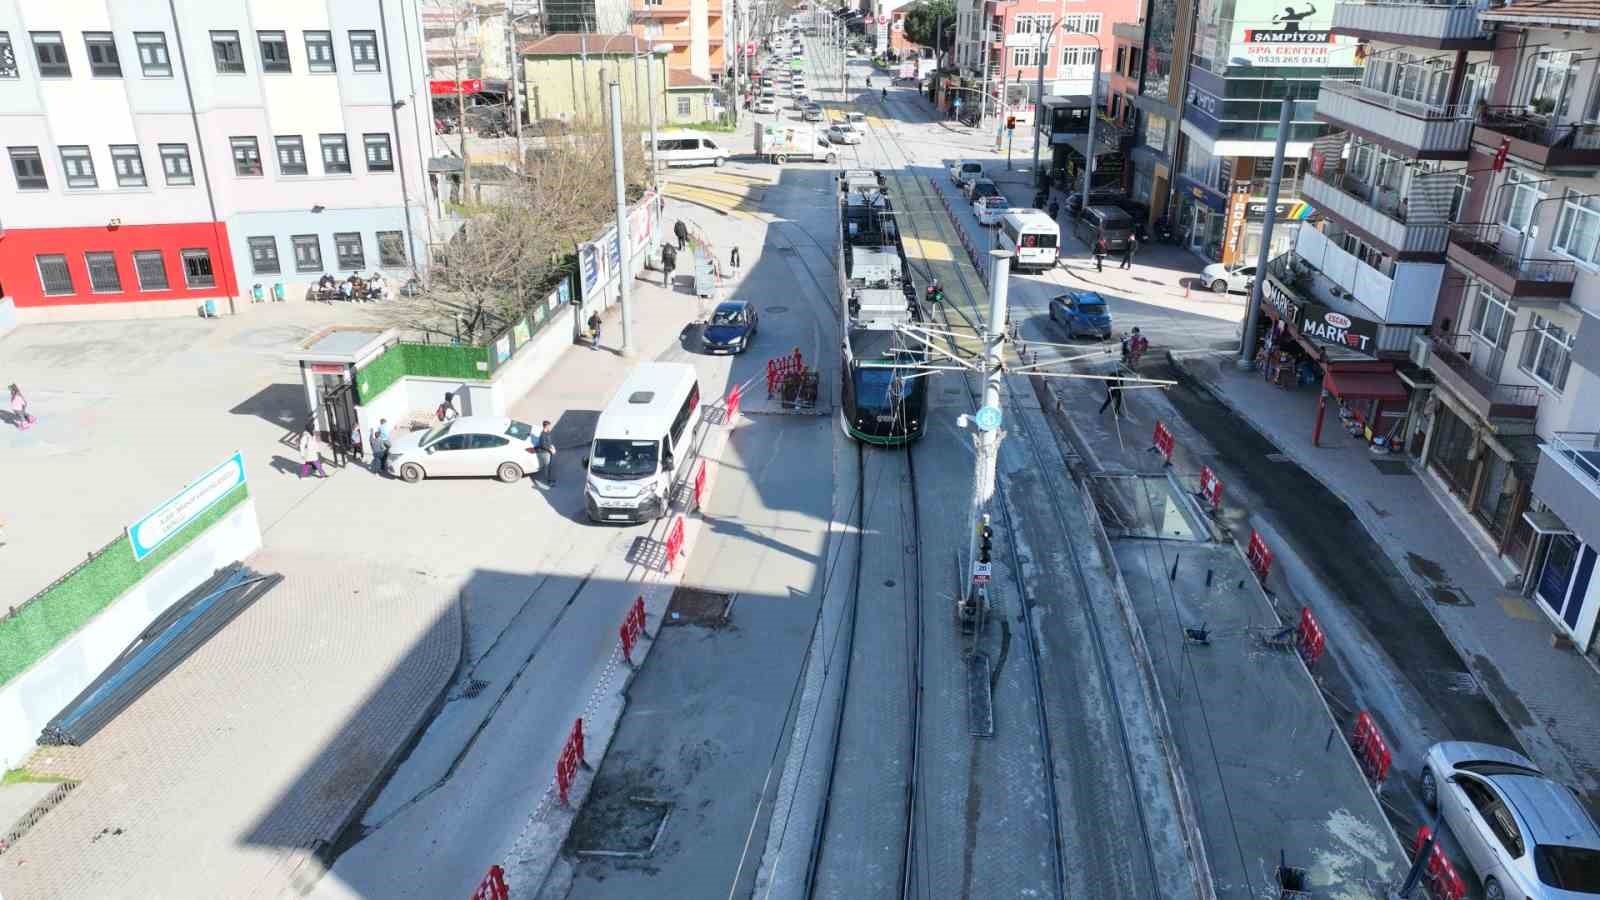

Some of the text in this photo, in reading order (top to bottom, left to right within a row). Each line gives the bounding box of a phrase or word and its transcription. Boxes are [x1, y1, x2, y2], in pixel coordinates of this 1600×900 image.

[1254, 31, 1327, 42] ŞAMPİYON
[1248, 47, 1328, 55] SPA CENTER
[1271, 286, 1299, 323] MARKET
[1304, 319, 1370, 350] MARKET
